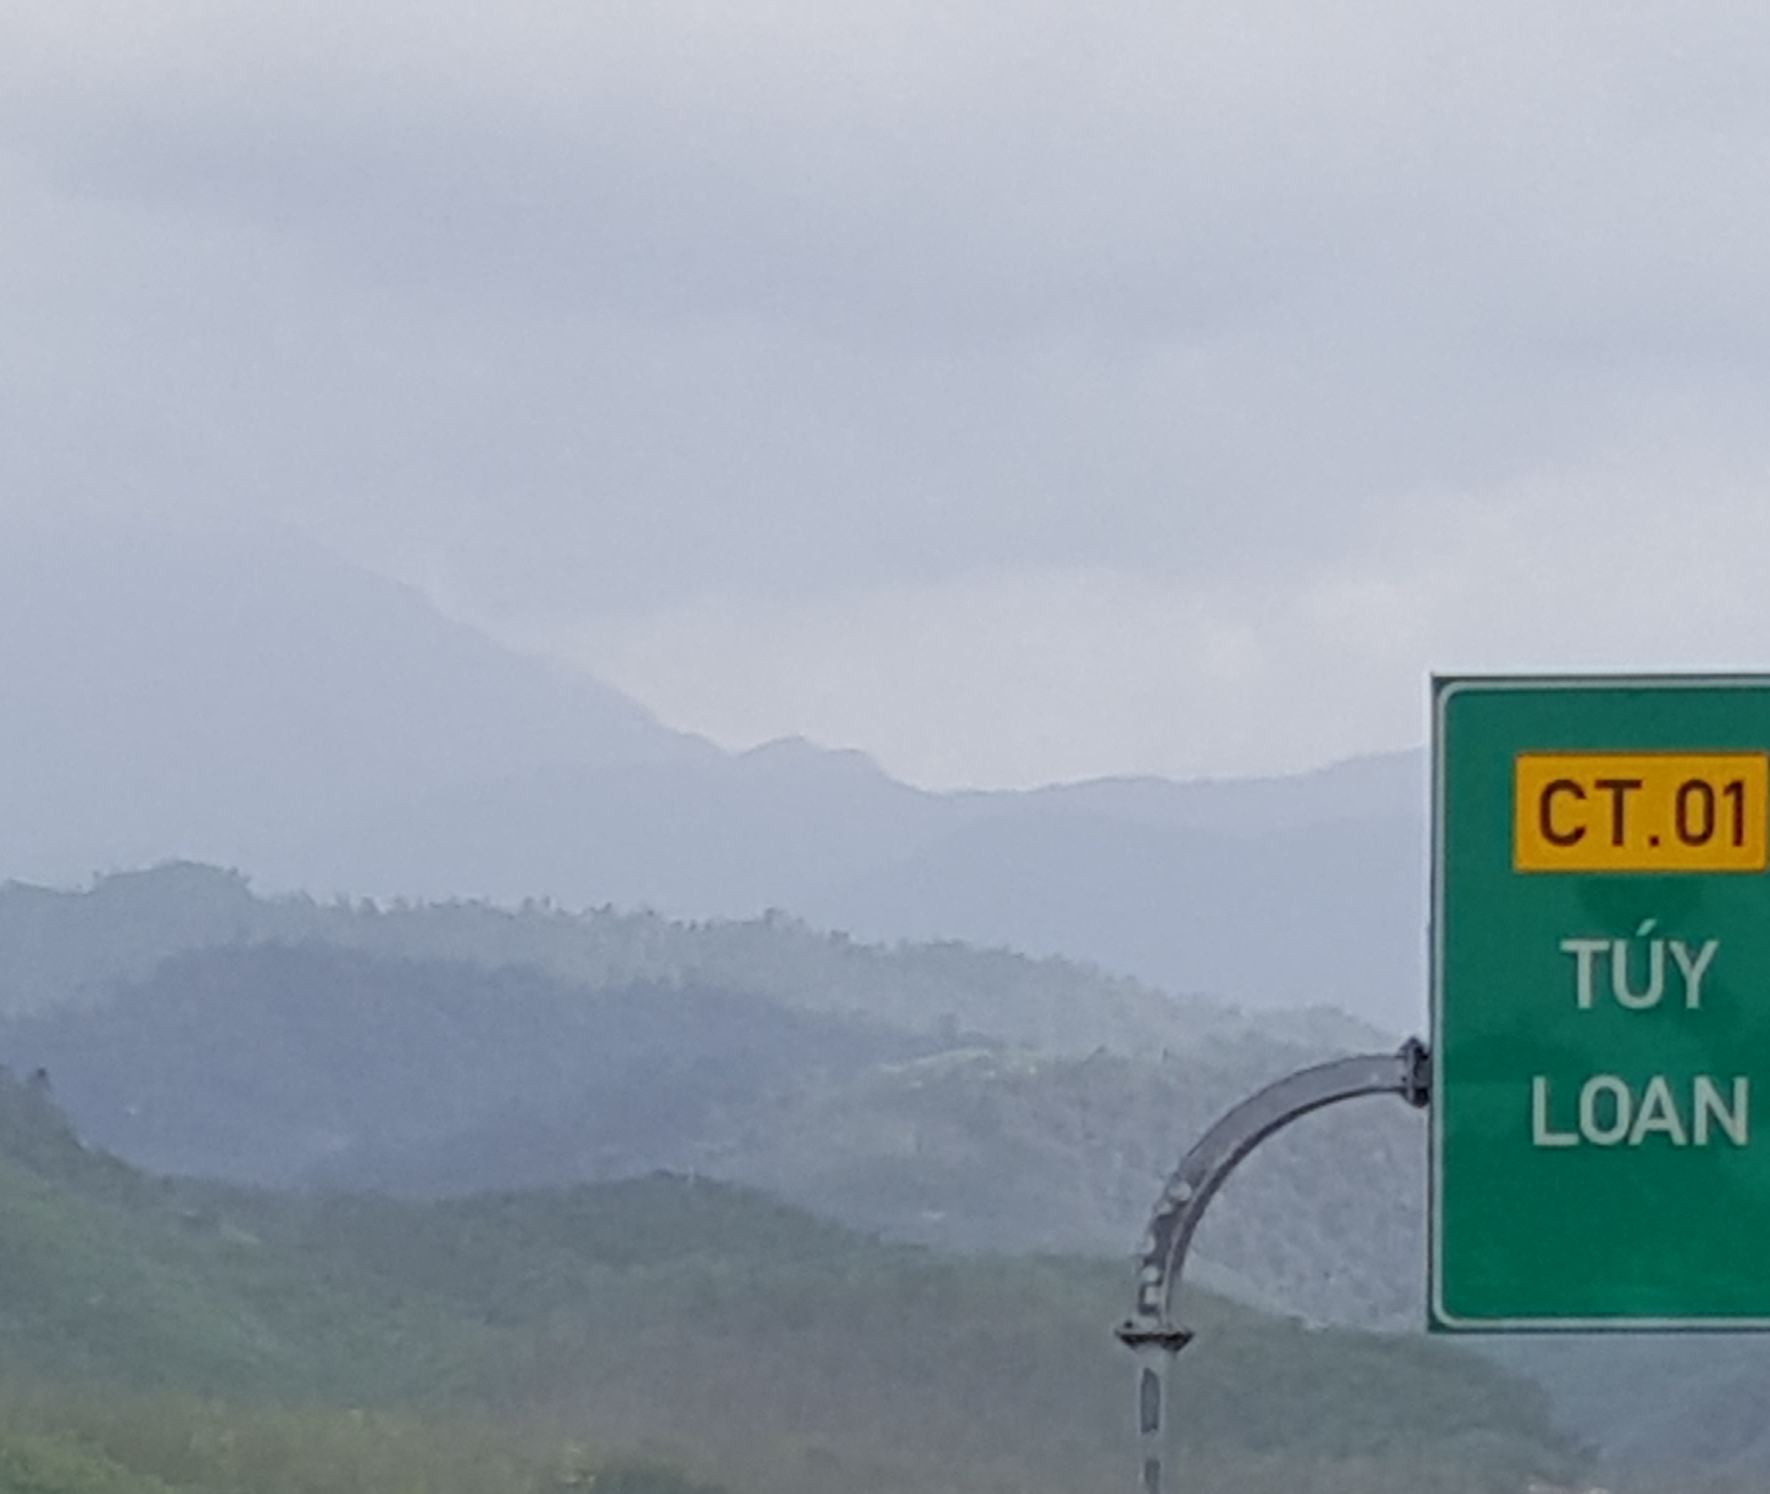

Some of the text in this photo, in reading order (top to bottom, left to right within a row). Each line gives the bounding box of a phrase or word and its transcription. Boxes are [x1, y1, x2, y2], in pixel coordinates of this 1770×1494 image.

[1538, 778, 1746, 848] CT.01
[1560, 919, 1720, 1010] TÚY
[1532, 1074, 1750, 1147] LOAN
